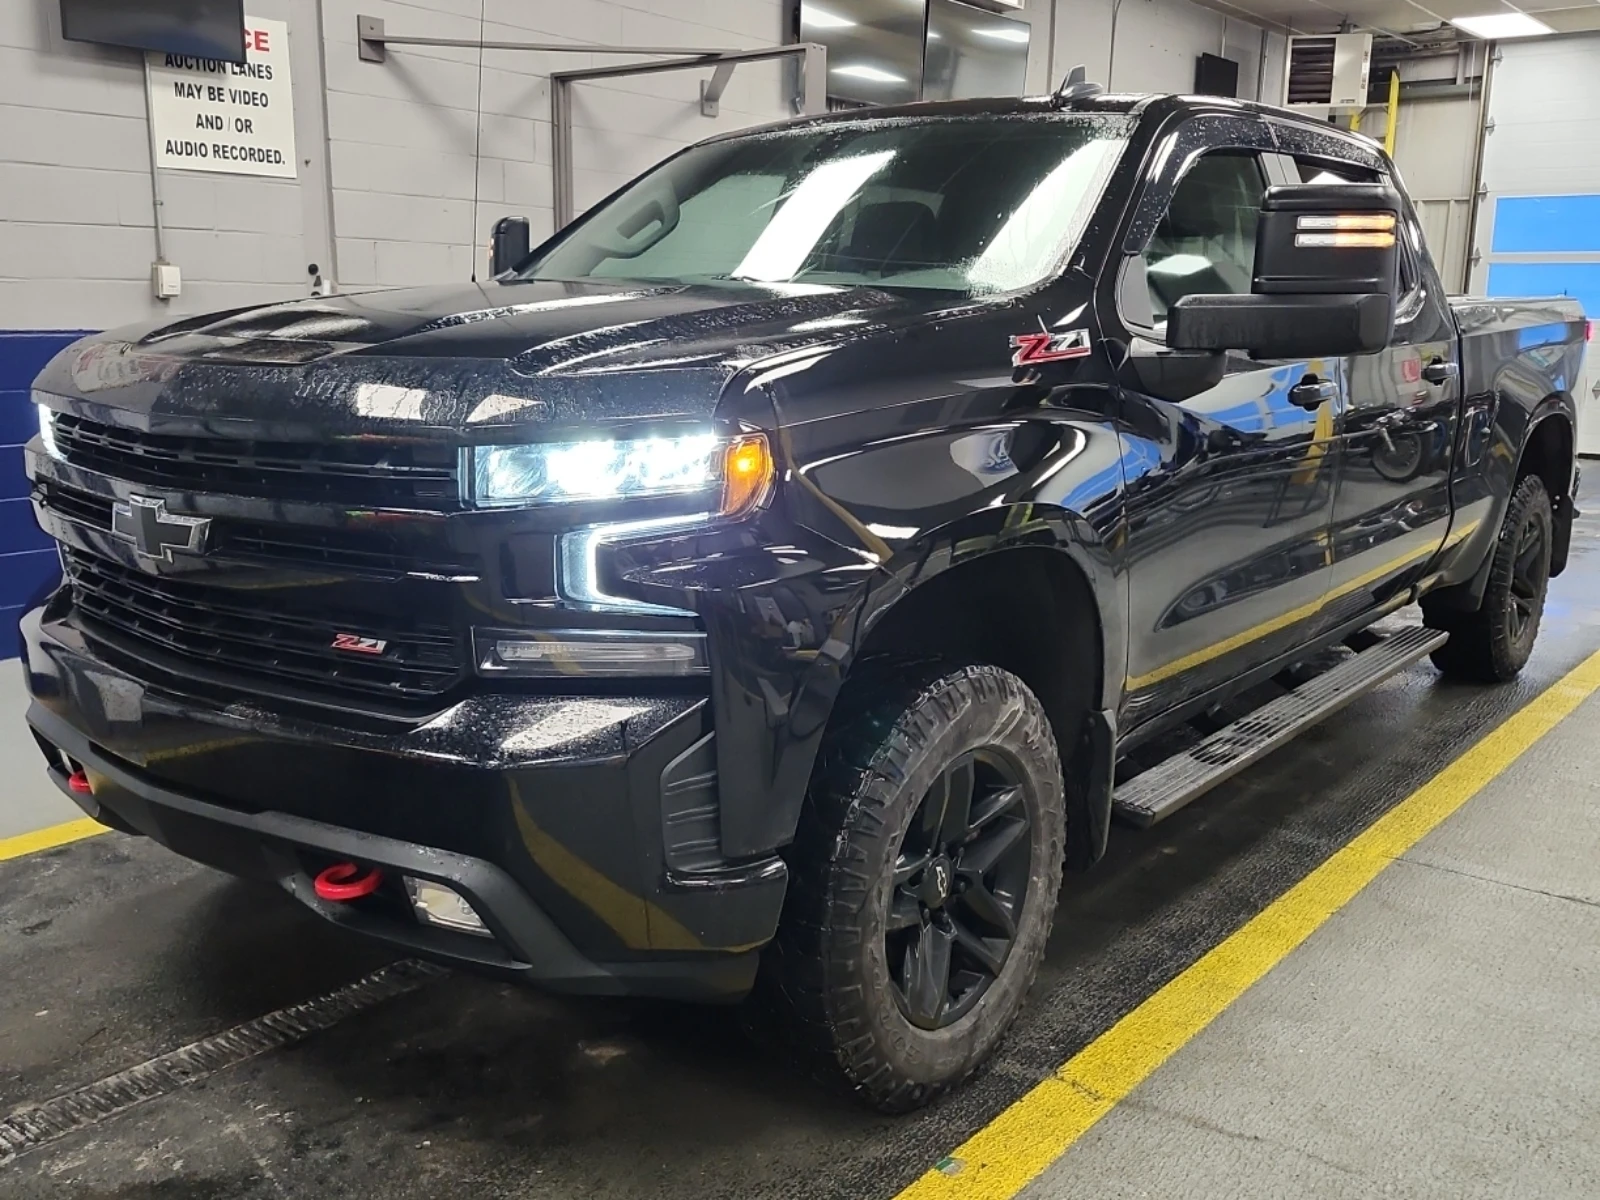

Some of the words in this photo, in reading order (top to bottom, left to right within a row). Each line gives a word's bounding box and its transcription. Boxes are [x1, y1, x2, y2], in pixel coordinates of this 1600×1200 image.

[165, 53, 226, 74] AUCTION
[231, 62, 273, 80] LANES
[174, 81, 202, 100] MAY
[208, 86, 225, 103] BE
[229, 88, 269, 108] VIDEO
[196, 113, 223, 131] AND
[235, 118, 253, 134] OR
[165, 139, 208, 158] AUDIO
[212, 143, 286, 165] RECORDED.
[1008, 328, 1091, 367] Z71
[331, 633, 387, 654] Z71
